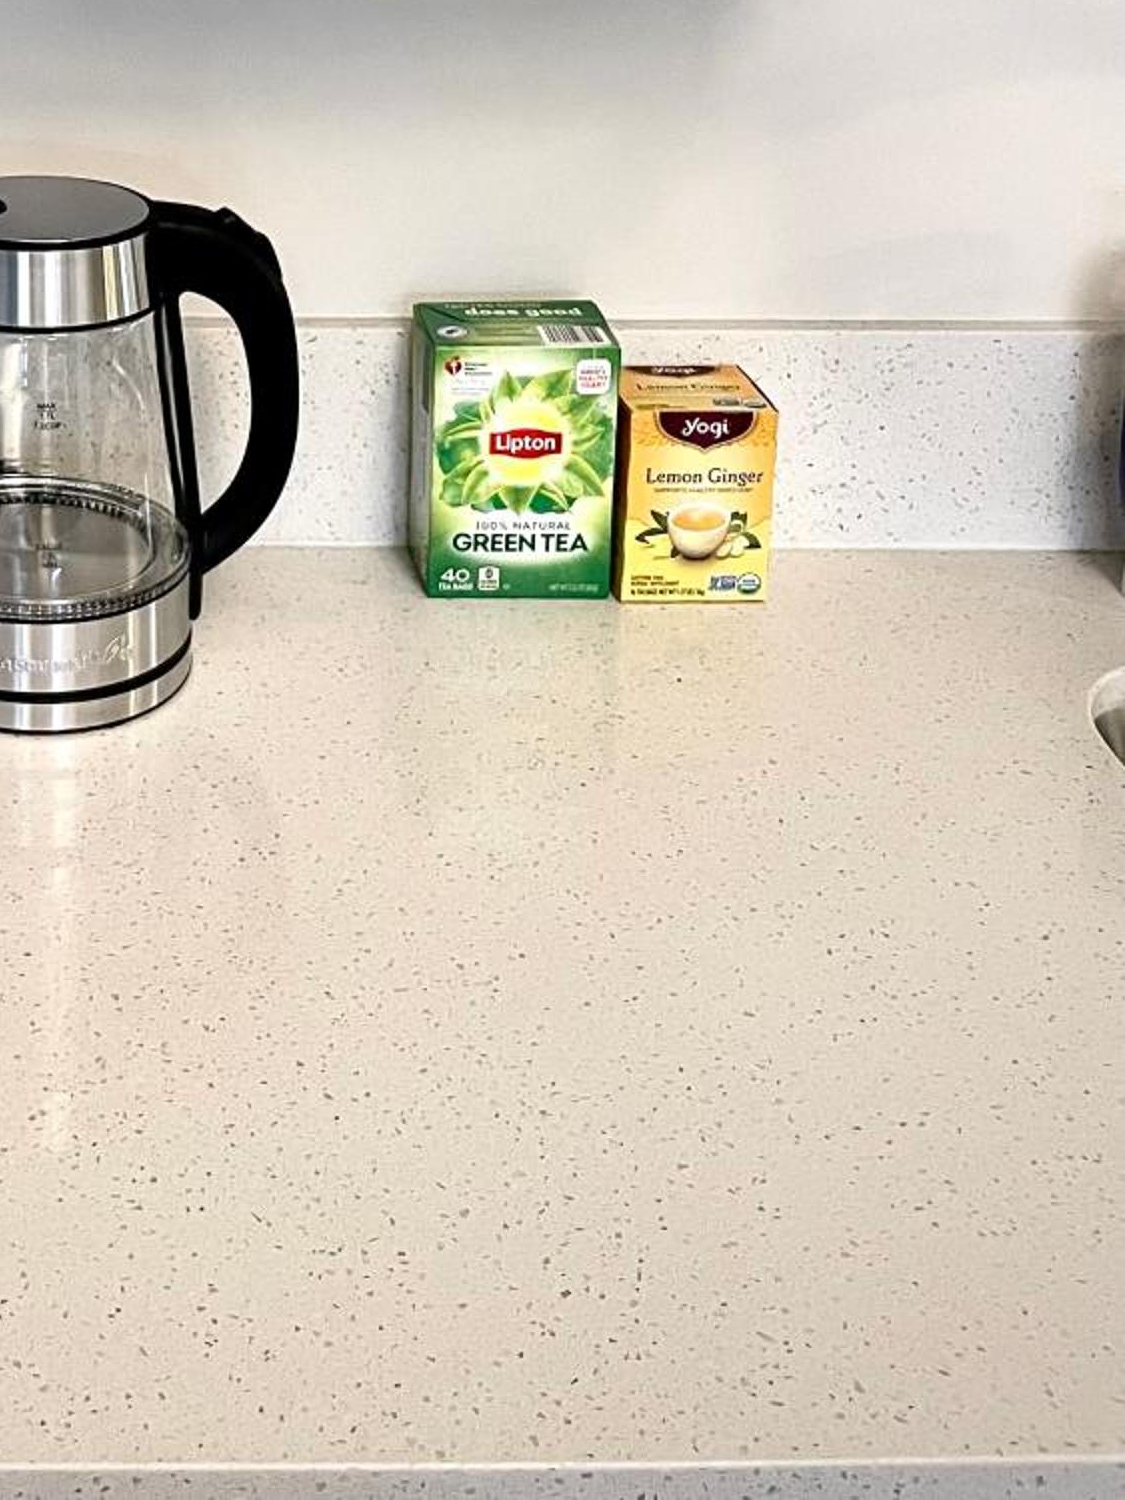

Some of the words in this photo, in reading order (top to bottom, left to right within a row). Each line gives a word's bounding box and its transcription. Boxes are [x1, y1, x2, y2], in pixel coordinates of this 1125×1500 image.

[495, 434, 557, 453] Lipton
[646, 467, 703, 484] Lemon
[707, 467, 764, 487] Ginger
[512, 520, 572, 531] NATURAL
[451, 532, 537, 553] GREEN
[540, 532, 589, 553] TEA
[439, 567, 471, 582] 40
